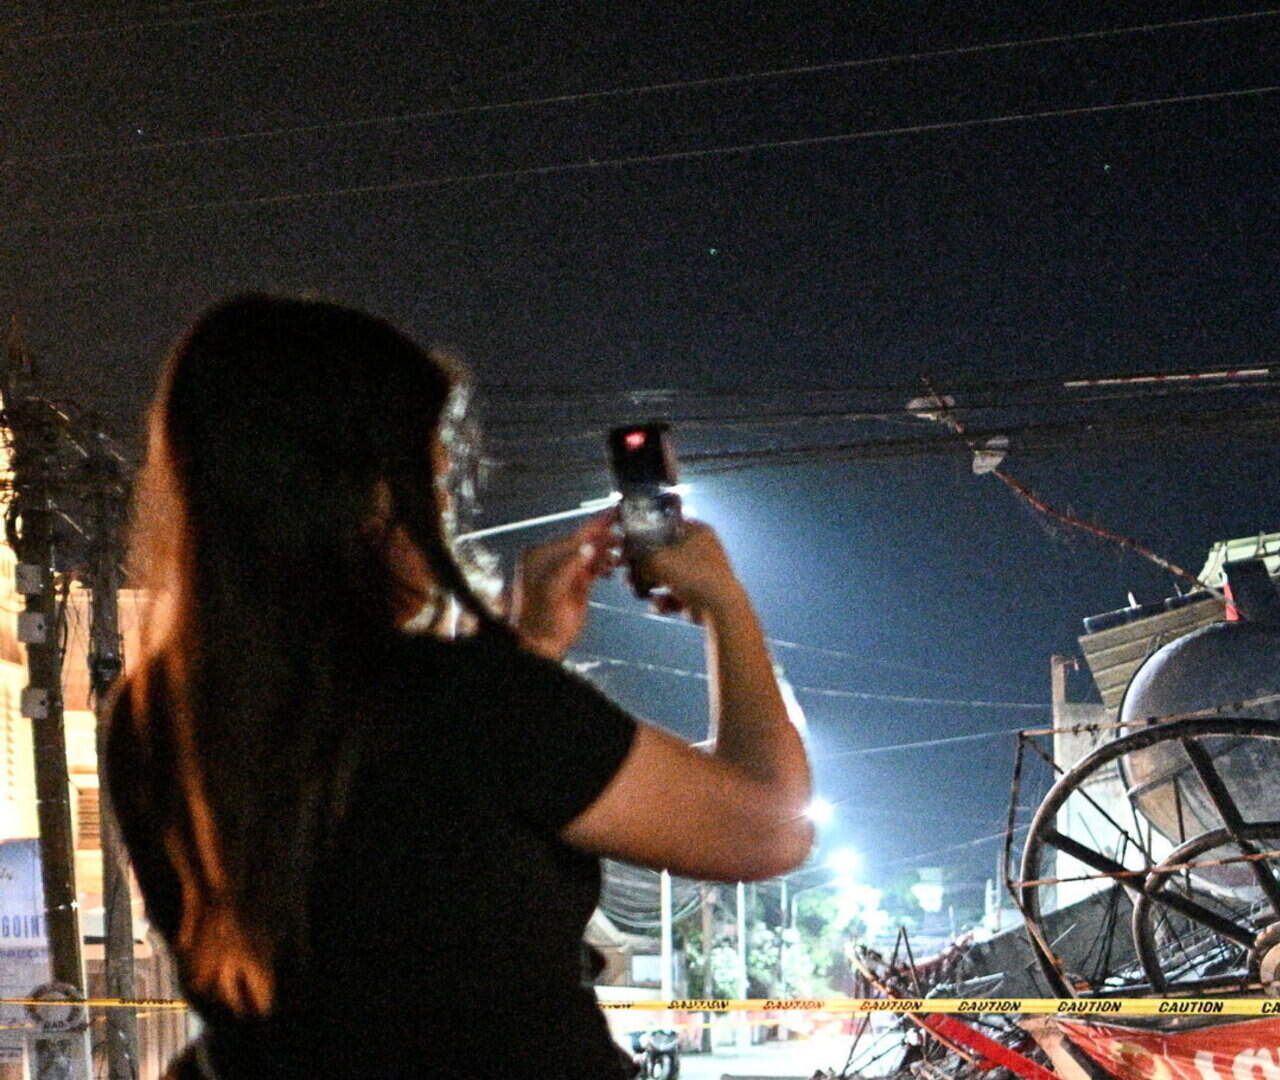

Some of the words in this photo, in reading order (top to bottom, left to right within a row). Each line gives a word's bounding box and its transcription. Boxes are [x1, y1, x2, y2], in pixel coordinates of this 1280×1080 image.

[860, 1001, 922, 1012] CAUTION
[958, 1001, 1021, 1012] CAUTION
[1057, 1001, 1121, 1013] CAUTION
[1159, 1001, 1223, 1013] CAUTION
